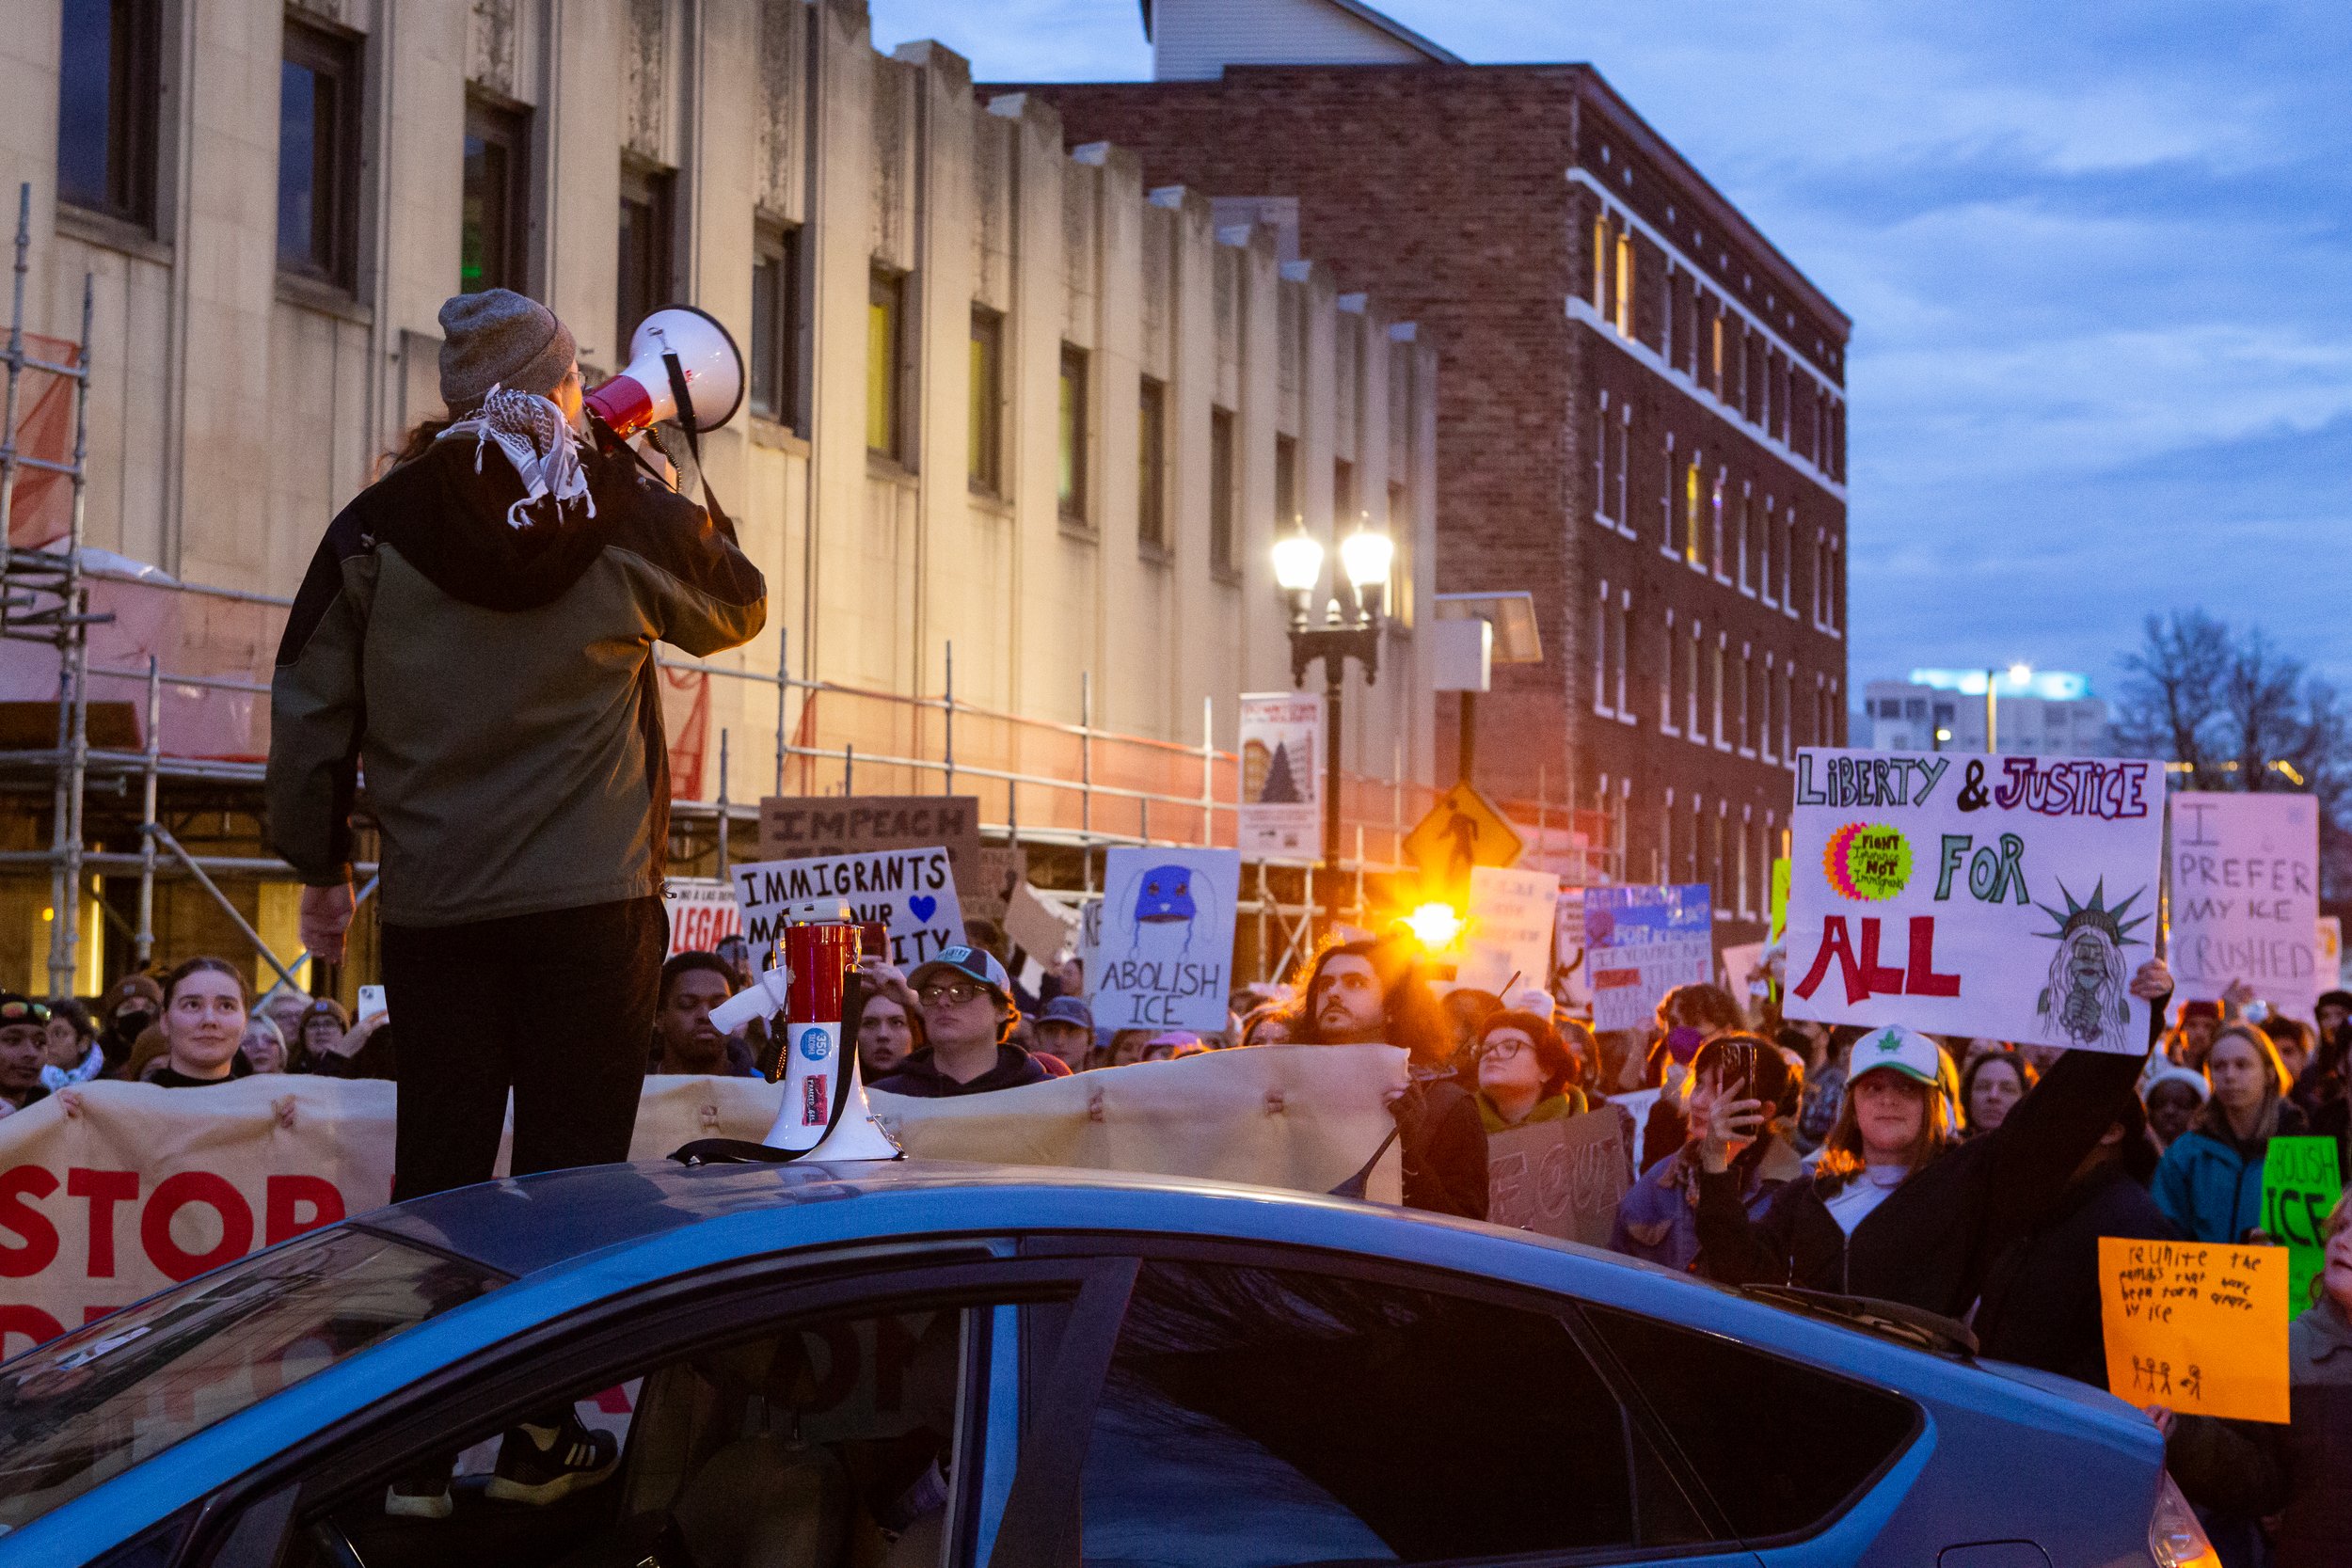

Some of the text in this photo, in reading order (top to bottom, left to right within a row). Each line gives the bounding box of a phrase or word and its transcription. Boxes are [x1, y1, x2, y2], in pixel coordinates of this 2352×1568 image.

[1957, 760, 1991, 812] &
[772, 808, 965, 842] IMPEACH
[1863, 834, 1899, 849] FIGHT
[2181, 803, 2219, 847] I
[740, 854, 946, 908] IMMIGRANTS
[1867, 860, 1898, 876] NOT
[1933, 832, 2030, 905] FOR
[2179, 852, 2312, 895] PREFER
[2181, 896, 2234, 924] MY
[1793, 914, 1962, 1006] ALL
[2174, 934, 2315, 979] CRUSHED
[1101, 960, 1220, 999] ABOLISH
[1129, 993, 1184, 1026] ICE
[816, 1034, 827, 1056] 350
[0, 1164, 346, 1282] STOP
[2129, 1245, 2261, 1271] reunite the
